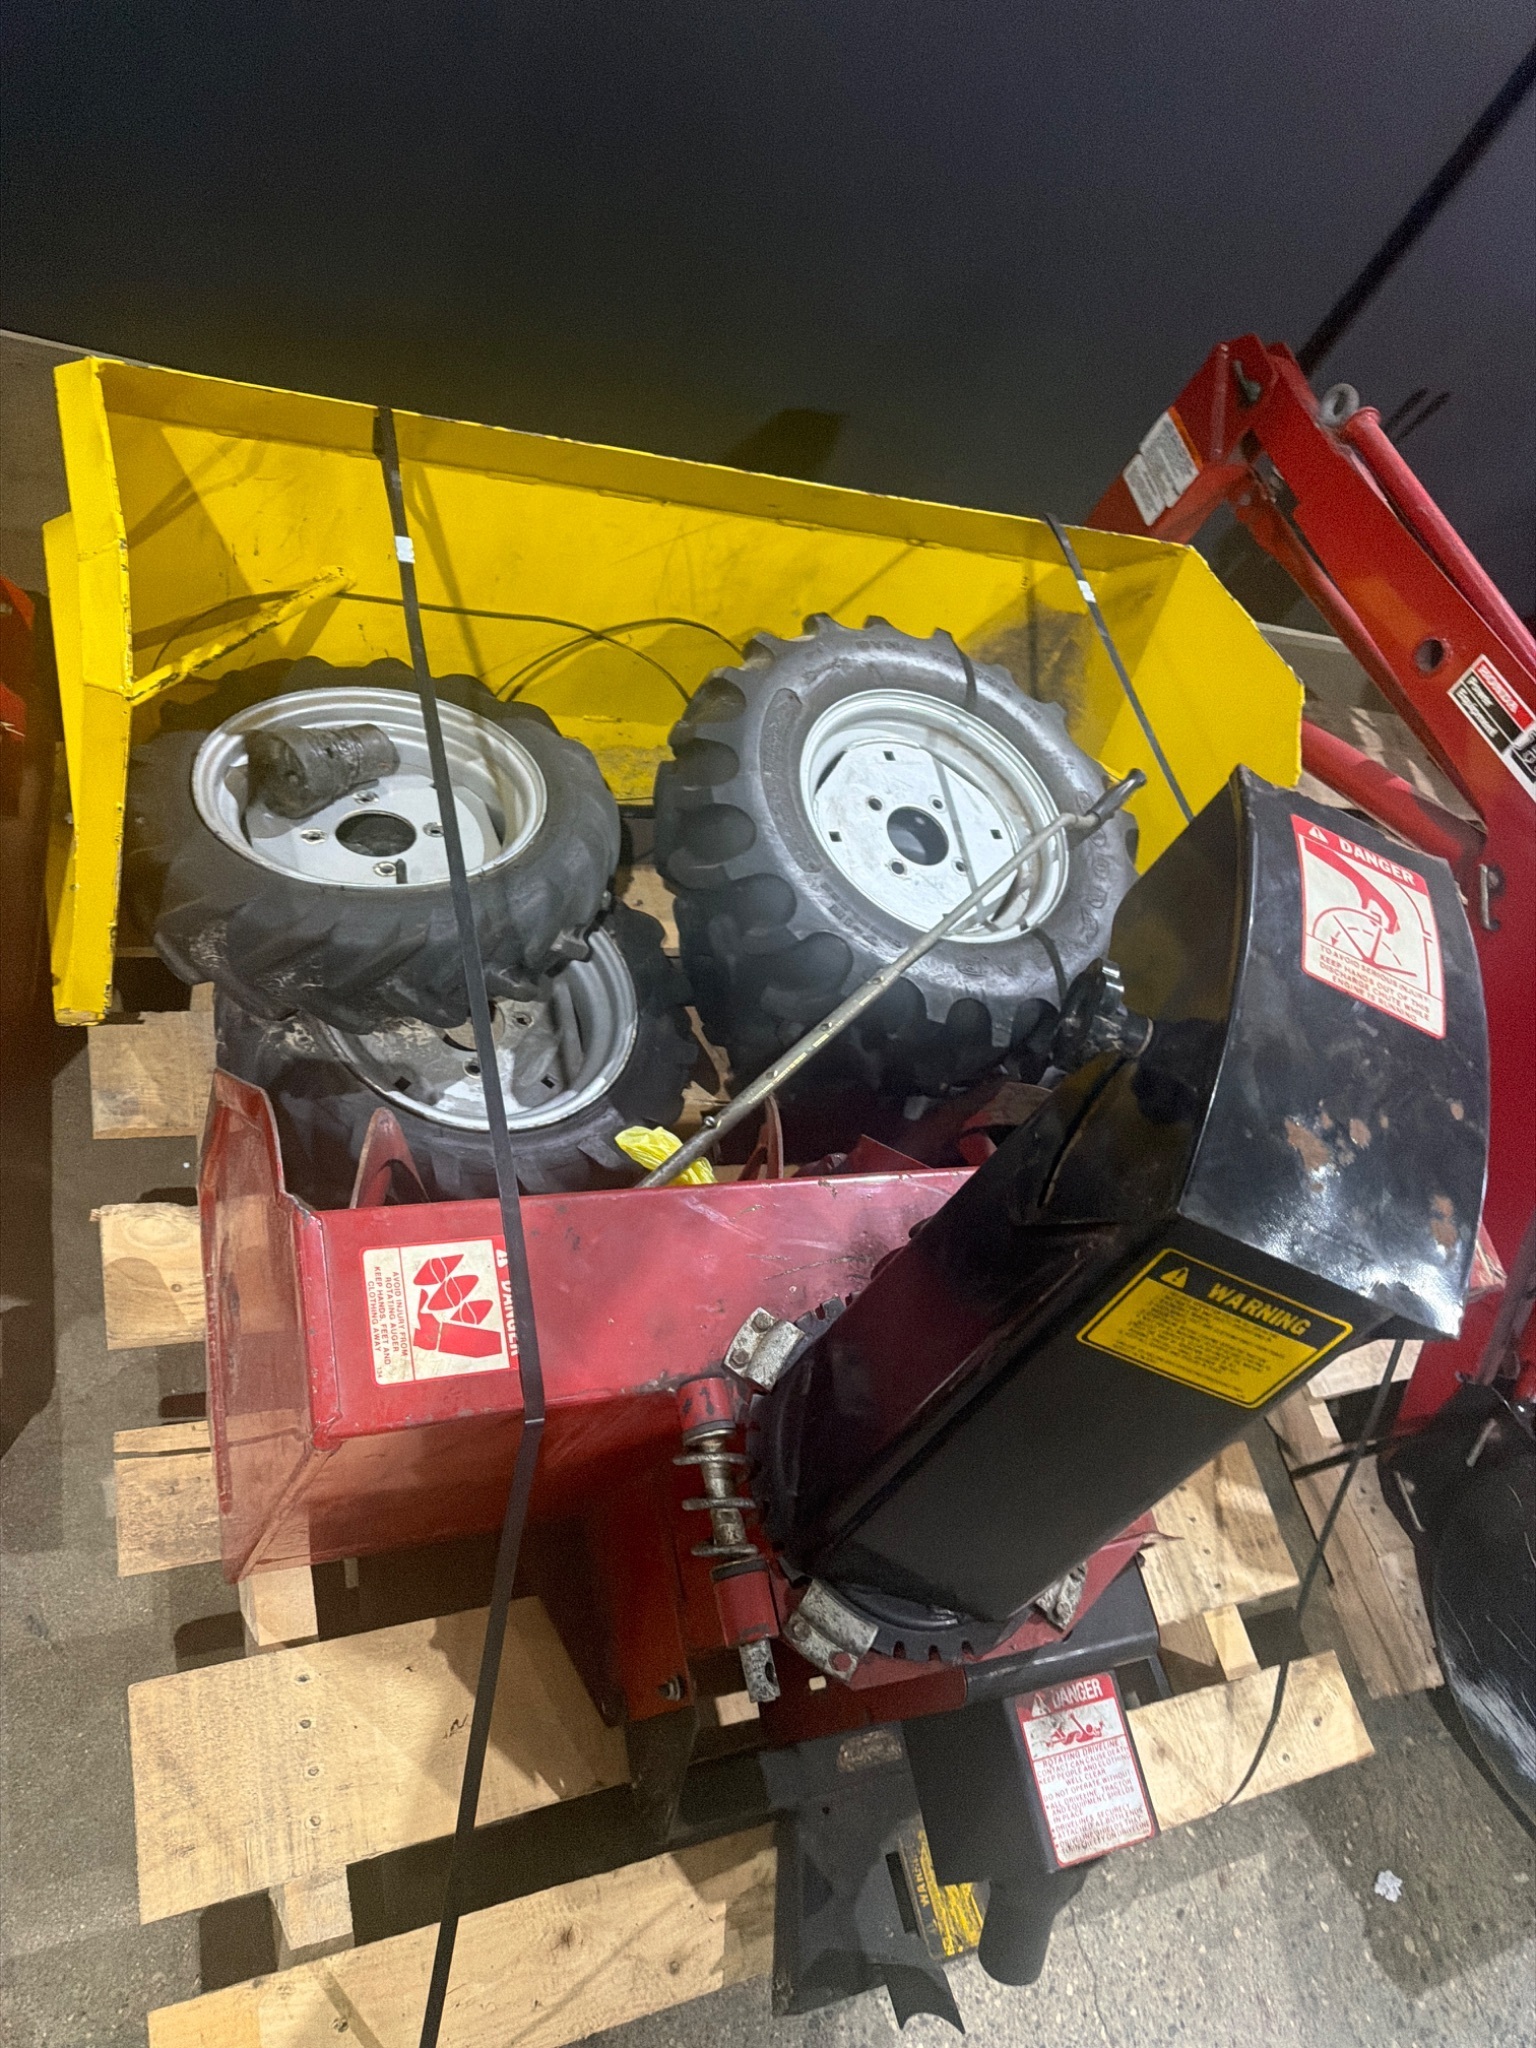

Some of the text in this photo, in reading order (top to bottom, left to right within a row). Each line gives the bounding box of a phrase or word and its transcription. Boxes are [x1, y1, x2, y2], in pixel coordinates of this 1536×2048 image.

[1338, 836, 1416, 887] DANGER
[1319, 960, 1368, 992] DISCHARGE
[1320, 953, 1429, 1013] KEEP HANDS OUT OF THIS
[1333, 950, 1359, 969] AVOID
[1361, 964, 1397, 987] SERIOUS
[374, 1266, 383, 1287] KEEP
[368, 1281, 382, 1352] CLOTHING AWAY
[385, 1277, 400, 1352] ROTATING AUGER
[393, 1271, 409, 1357] AVOID INJURY FROM
[1206, 1282, 1312, 1337] WARNING
[380, 1324, 389, 1344] FEET
[383, 1347, 392, 1365] AND
[1051, 1677, 1103, 1708] DANGER
[1036, 1762, 1069, 1779] CONTACT
[1070, 1757, 1084, 1768] CAN
[1084, 1750, 1106, 1764] CAUSE
[1042, 1739, 1119, 1768] ROTATING DRIVELINE
[1056, 1766, 1082, 1780] PEOPLE
[1082, 1761, 1097, 1772] AND
[1065, 1767, 1106, 1786] WELL CLEAR
[1054, 1788, 1069, 1799] NOT
[1070, 1779, 1100, 1794] OPERATE
